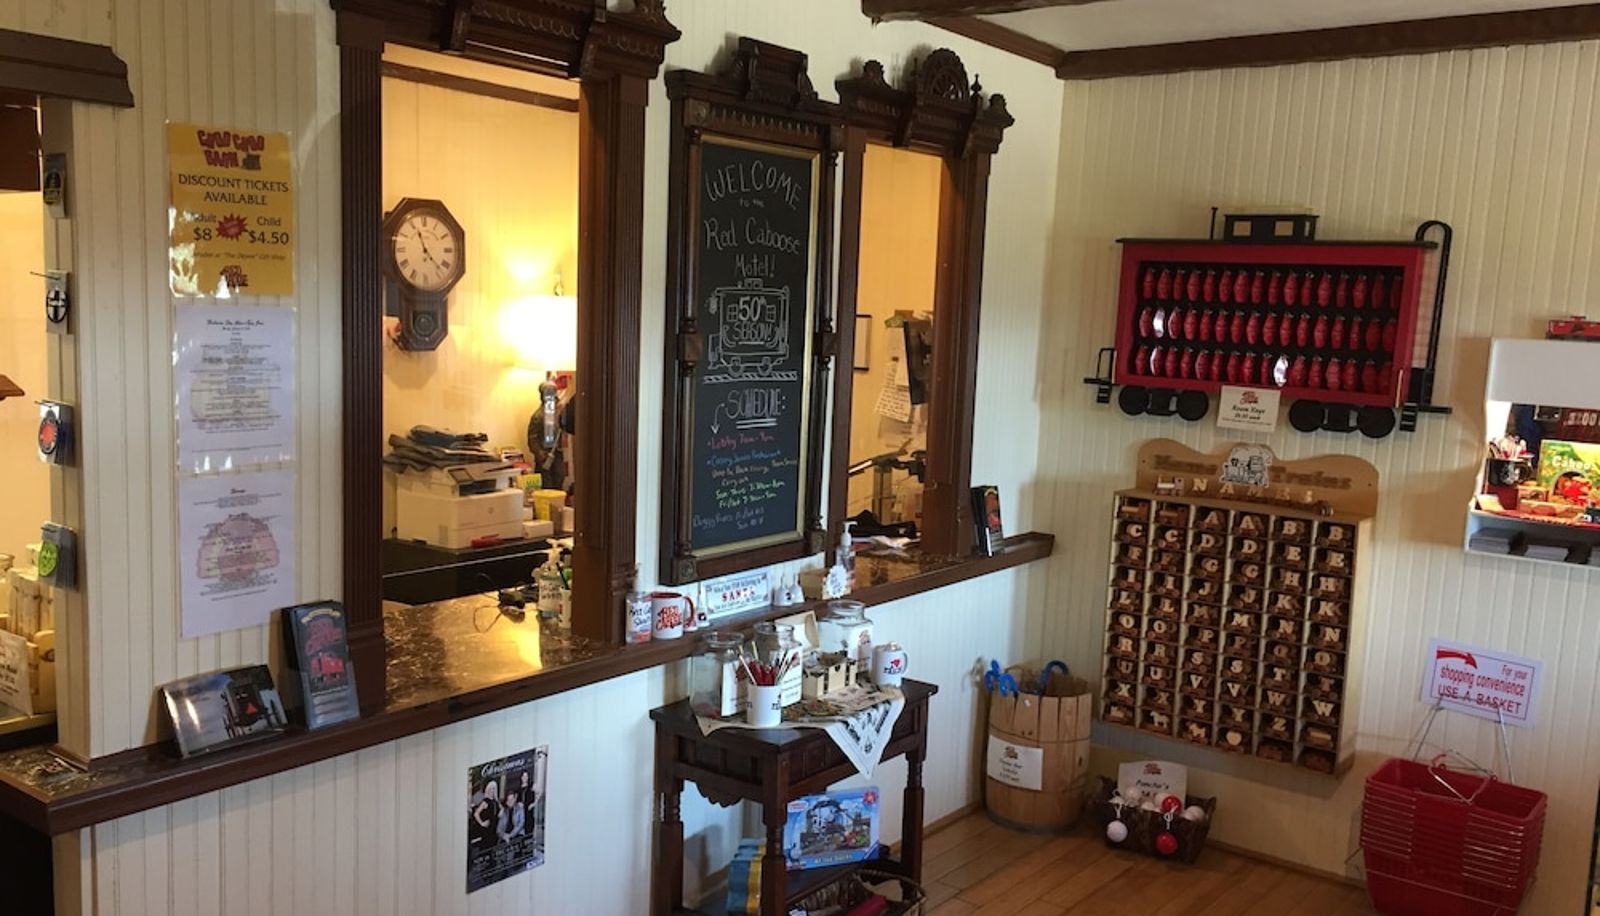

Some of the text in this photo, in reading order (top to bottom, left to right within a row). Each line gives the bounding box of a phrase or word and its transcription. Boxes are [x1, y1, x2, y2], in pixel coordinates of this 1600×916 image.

[178, 173, 289, 192] DISCOUNT TICKETS
[705, 160, 801, 210] WELCOME
[203, 191, 268, 206] AVAILABLE
[193, 226, 213, 242] $8
[256, 215, 281, 227] Child
[704, 217, 801, 255] Red Caboose
[249, 230, 289, 246] $4.50
[734, 254, 776, 278] Motel!
[1204, 511, 1343, 540] A A B B
[1126, 523, 1344, 567] C C D D E E
[1205, 559, 1218, 573] G
[1245, 564, 1259, 578] G
[1320, 577, 1336, 591] H
[1198, 582, 1211, 595] J
[1242, 590, 1257, 603] J
[1277, 594, 1292, 609] K
[1319, 601, 1335, 616] K
[1120, 591, 1340, 641] L L M M N N
[1121, 615, 1135, 629] O
[1153, 620, 1166, 633] O
[1201, 629, 1214, 643] P
[1120, 637, 1133, 651] R
[1192, 651, 1203, 664] S
[1230, 660, 1243, 674] S
[1273, 667, 1286, 681] T
[1502, 664, 1513, 677] For
[1120, 660, 1335, 717] U U V V W W
[1440, 664, 1526, 697] shopping convenience
[1118, 682, 1131, 697] X
[1194, 699, 1206, 713] Y
[1232, 707, 1246, 722] Y
[1272, 717, 1286, 731] Z
[1438, 684, 1522, 715] USE A BASKET
